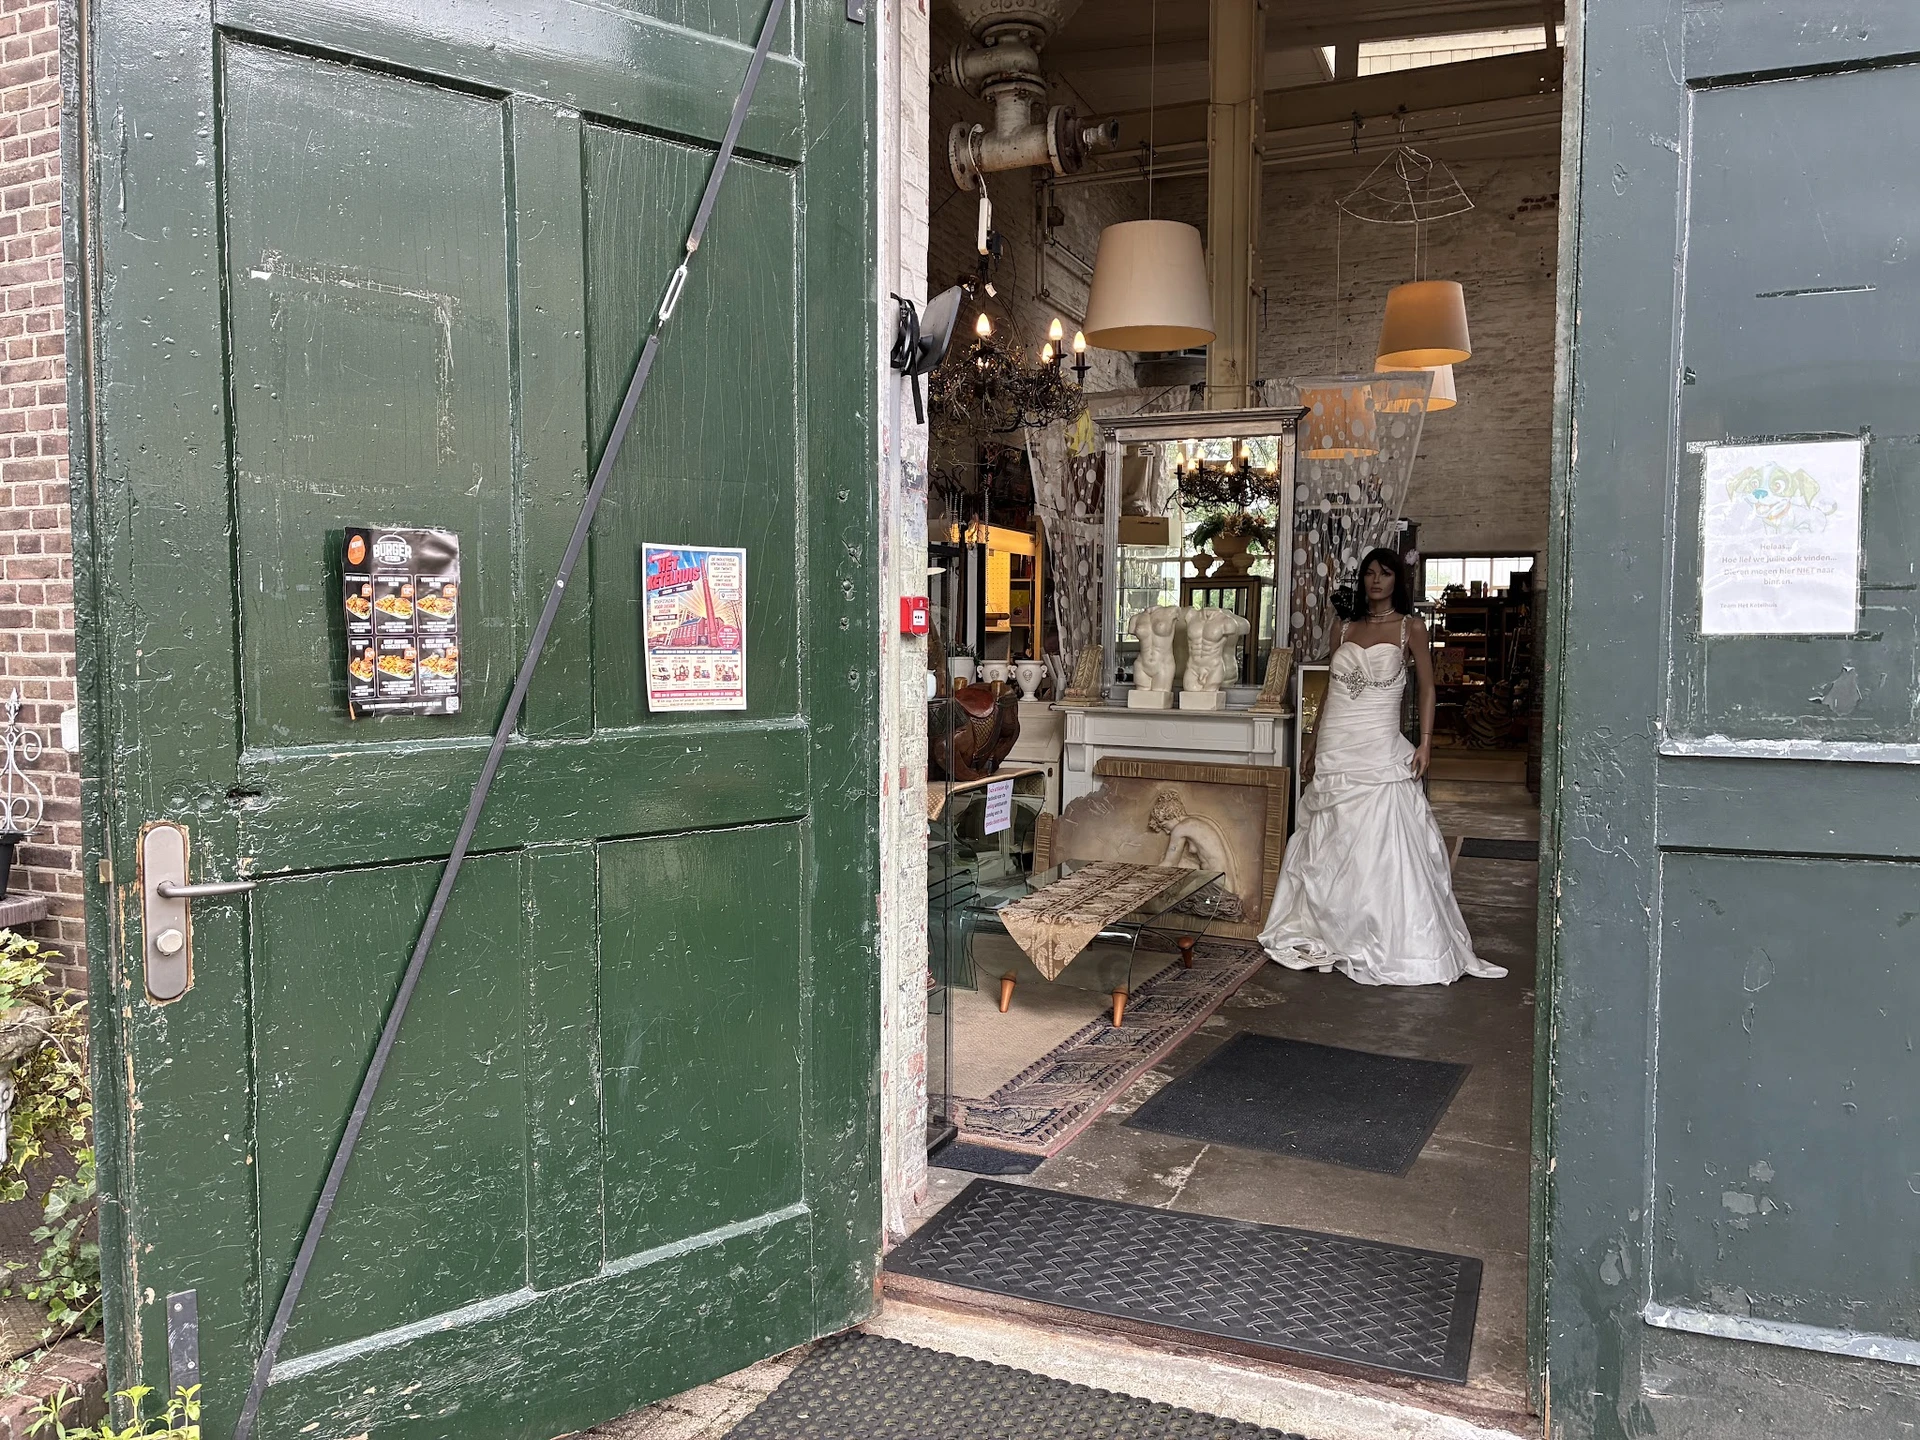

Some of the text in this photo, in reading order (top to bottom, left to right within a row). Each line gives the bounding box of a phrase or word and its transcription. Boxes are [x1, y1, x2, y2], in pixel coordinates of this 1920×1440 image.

[373, 543, 412, 558] BURGER
[658, 556, 680, 573] HET
[1766, 556, 1786, 564] jullie
[1803, 554, 1838, 562] vinden...
[647, 567, 700, 591] KETELHUIS
[1724, 568, 1749, 576] Dieren
[1779, 567, 1795, 575] hier
[1796, 567, 1814, 575] NIET
